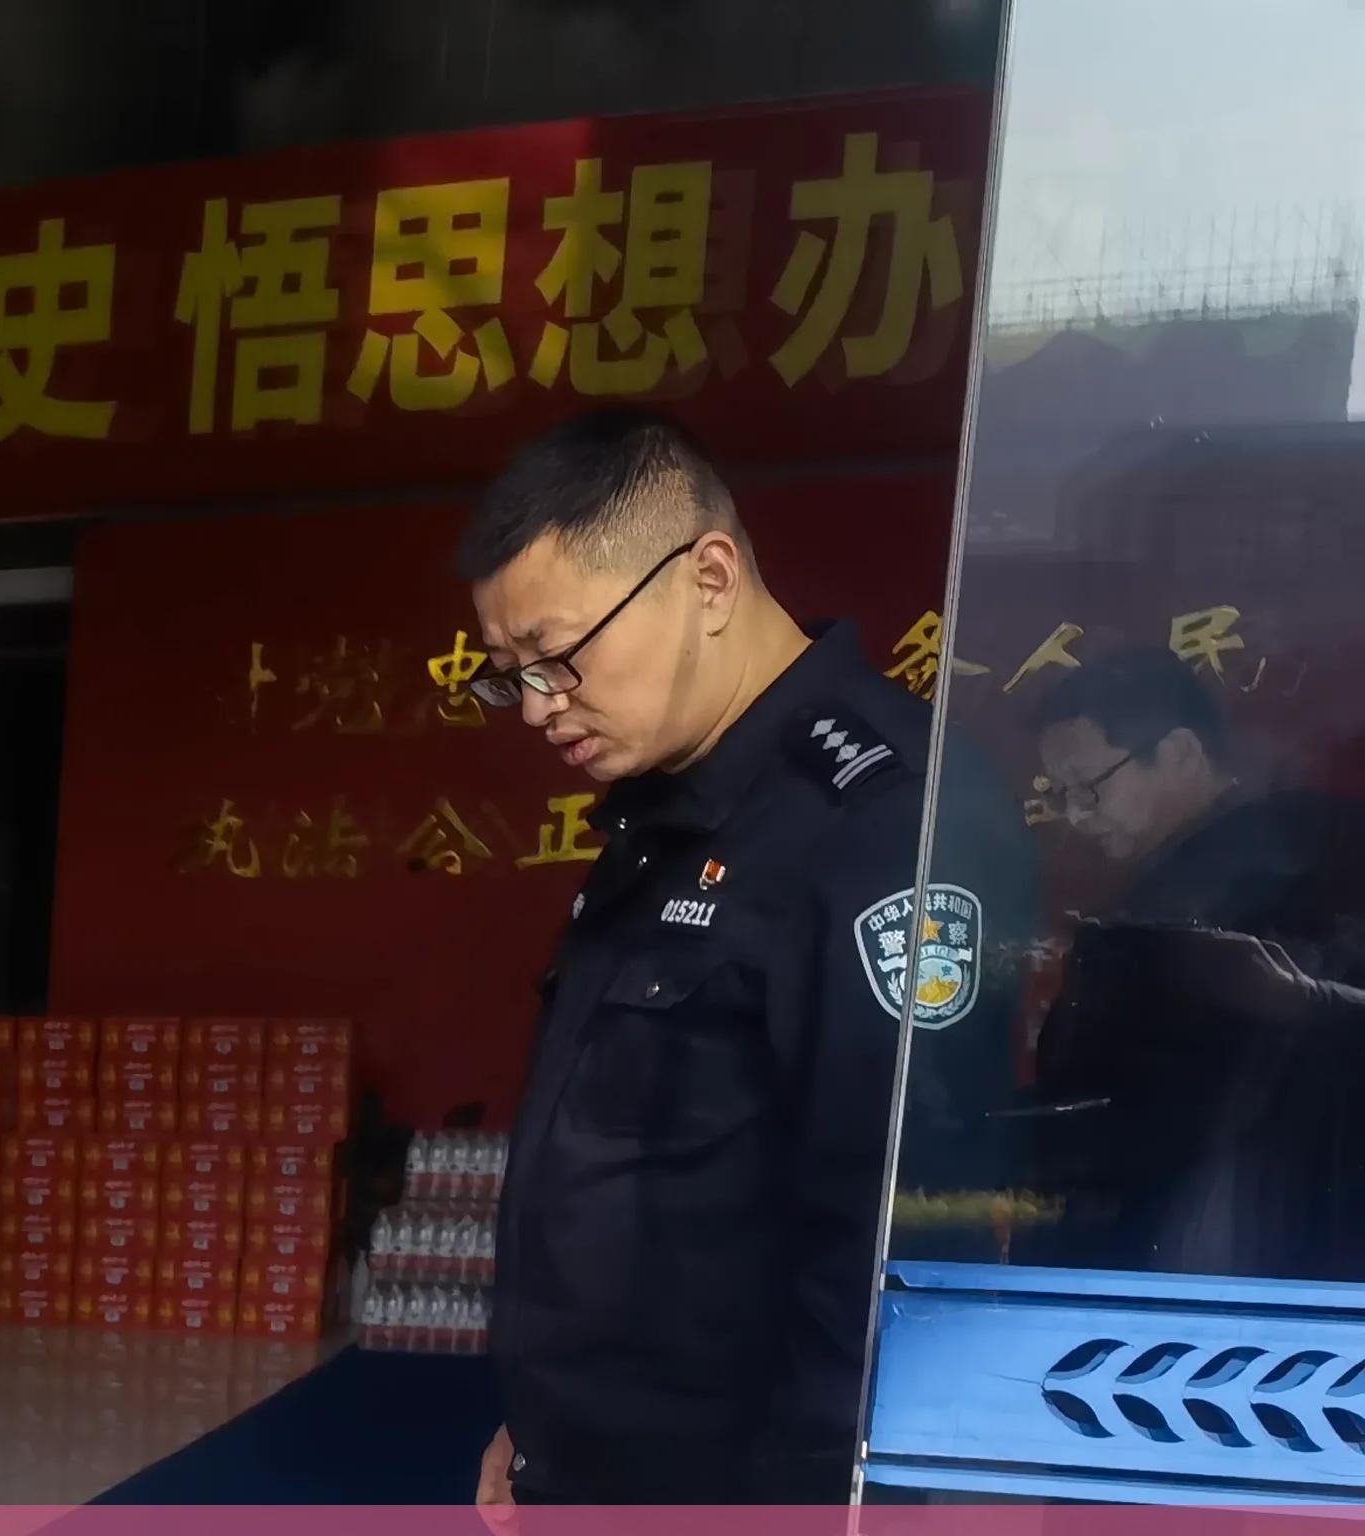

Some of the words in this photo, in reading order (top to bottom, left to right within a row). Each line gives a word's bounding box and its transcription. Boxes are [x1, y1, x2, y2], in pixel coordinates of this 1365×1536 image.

[174, 158, 714, 436] 悟思想
[770, 132, 963, 388] 办
